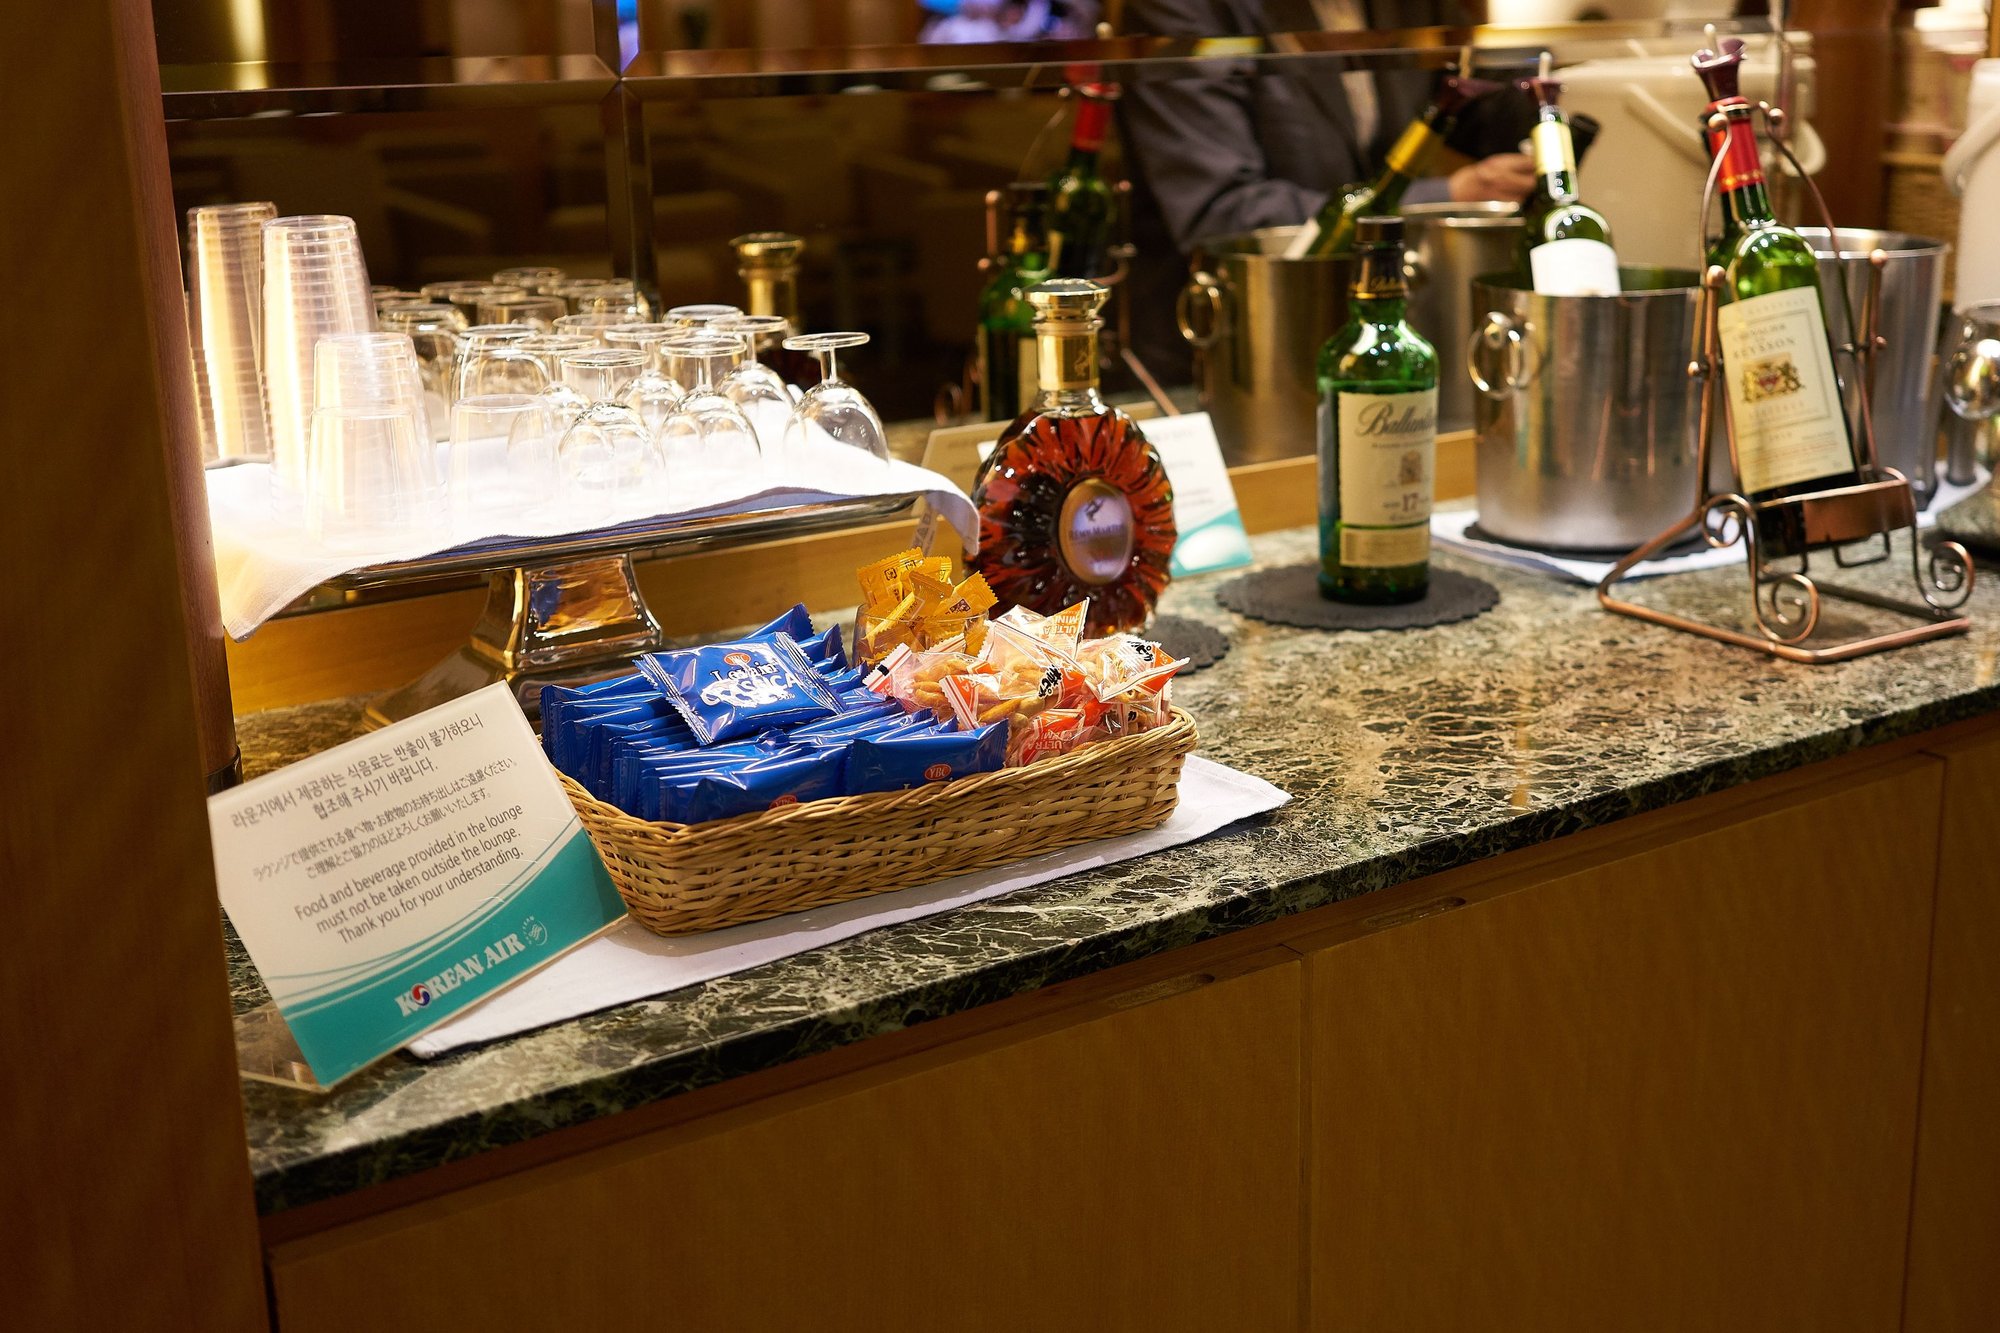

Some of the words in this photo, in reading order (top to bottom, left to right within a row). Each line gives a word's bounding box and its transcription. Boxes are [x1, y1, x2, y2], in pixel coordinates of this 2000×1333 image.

[231, 791, 297, 828] 라운지에서
[295, 772, 348, 801] 제공하는
[347, 752, 395, 780] 식음료는
[393, 736, 431, 762] 반출이
[429, 713, 484, 747] 불가하오니
[313, 791, 353, 820] 협조해
[351, 776, 389, 803] 주시기
[387, 756, 439, 786] 바랍니다.
[928, 765, 950, 778] YBC
[294, 894, 328, 921] Food
[330, 881, 354, 906] and
[353, 860, 408, 895] beverage
[408, 833, 456, 872] provided
[455, 830, 468, 843] in
[467, 822, 488, 839] the
[485, 804, 524, 829] lounge
[316, 913, 348, 934] must
[349, 900, 372, 920] not
[371, 888, 388, 909] be
[387, 875, 420, 902] taken
[421, 854, 461, 883] outside
[461, 846, 481, 862] the
[478, 828, 521, 854] lounge.
[337, 919, 376, 944] Thank
[377, 908, 400, 928] you
[400, 896, 419, 917] for
[418, 887, 446, 907] your
[446, 844, 524, 892] understanding.
[394, 953, 485, 1017] KOREAN
[484, 933, 526, 969] AIR
